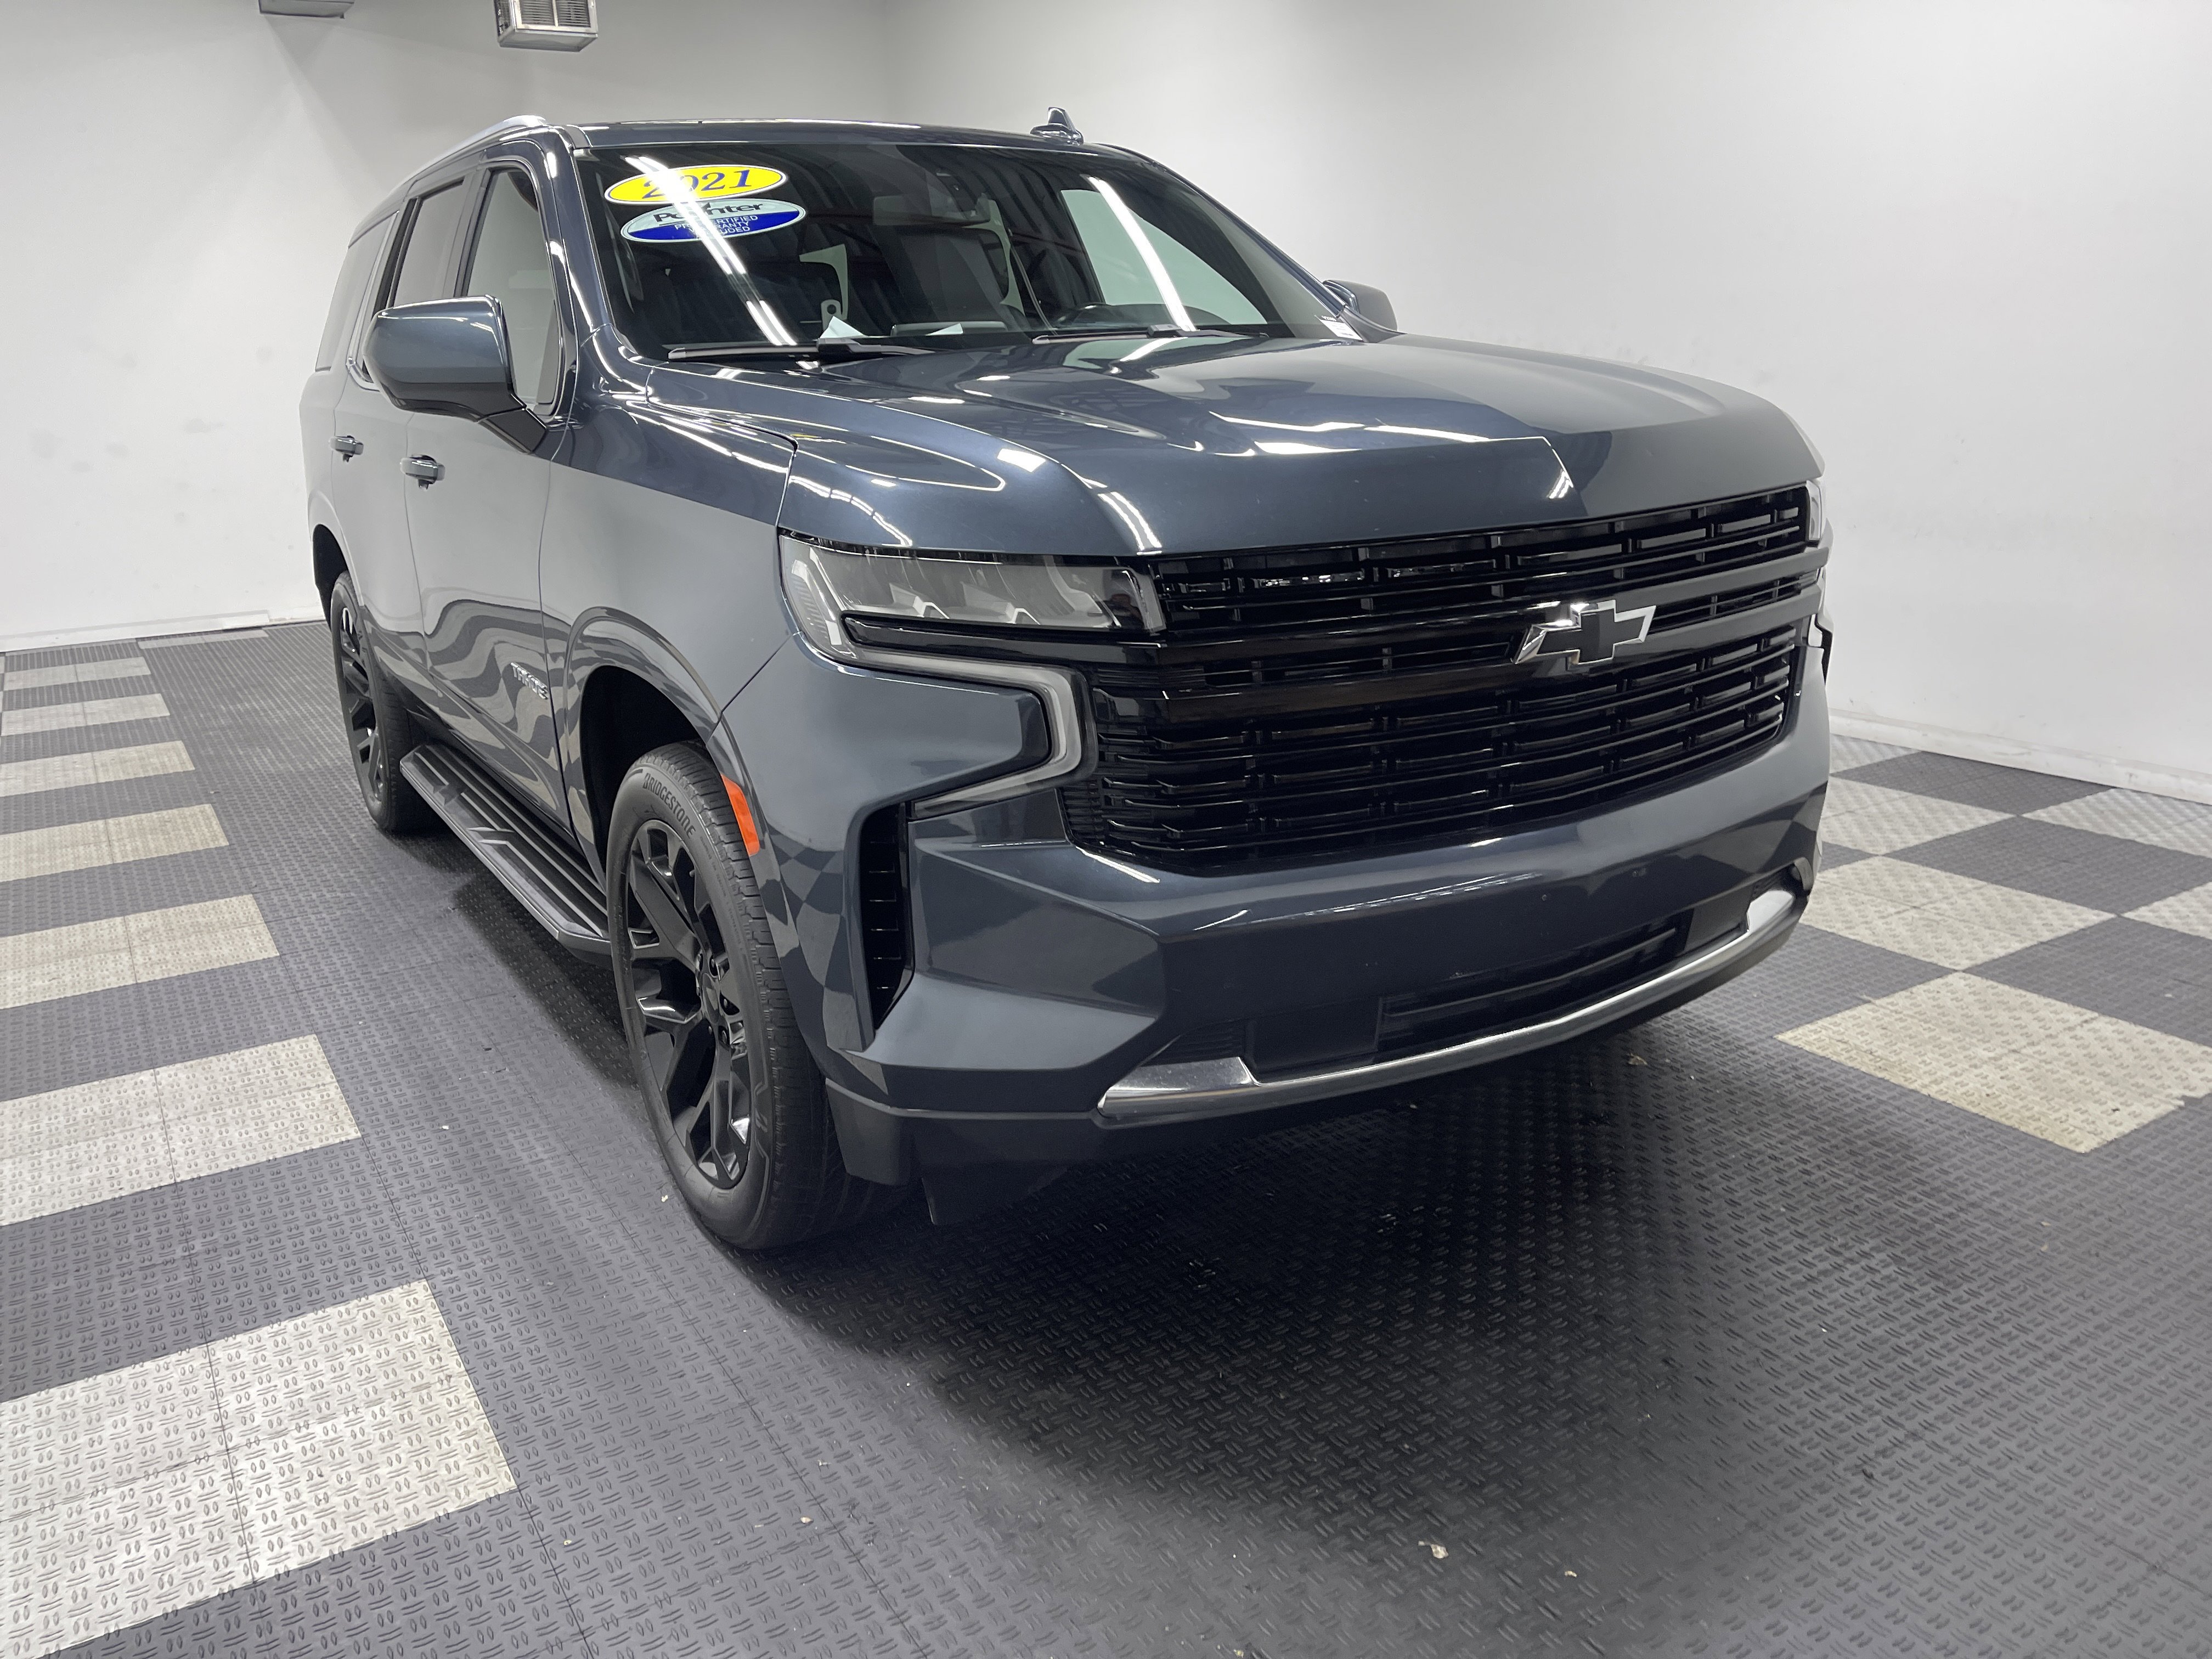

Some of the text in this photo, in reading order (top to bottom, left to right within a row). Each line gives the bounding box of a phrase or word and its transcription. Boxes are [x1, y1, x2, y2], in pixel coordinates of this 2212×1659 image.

[653, 202, 763, 222] Ponter
[712, 215, 758, 226] ERTIFIED
[510, 662, 549, 699] TAHOE
[642, 772, 696, 839] BRIDGESTONE
